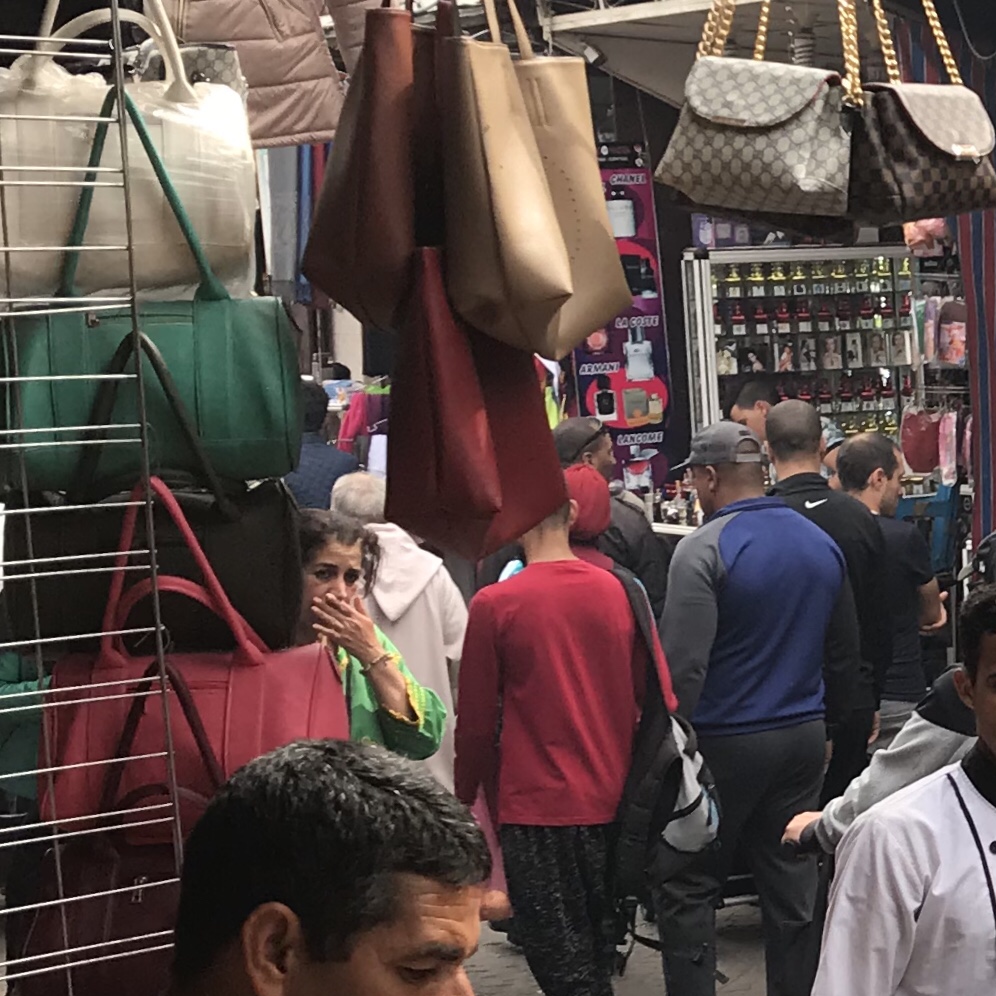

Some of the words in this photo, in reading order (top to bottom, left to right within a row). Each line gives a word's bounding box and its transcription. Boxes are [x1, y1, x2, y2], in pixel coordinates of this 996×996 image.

[610, 174, 646, 185] CHANEL
[615, 317, 629, 328] LA
[629, 315, 660, 327] COSTE
[579, 362, 621, 375] ARMANI
[617, 431, 664, 446] LANCOME
